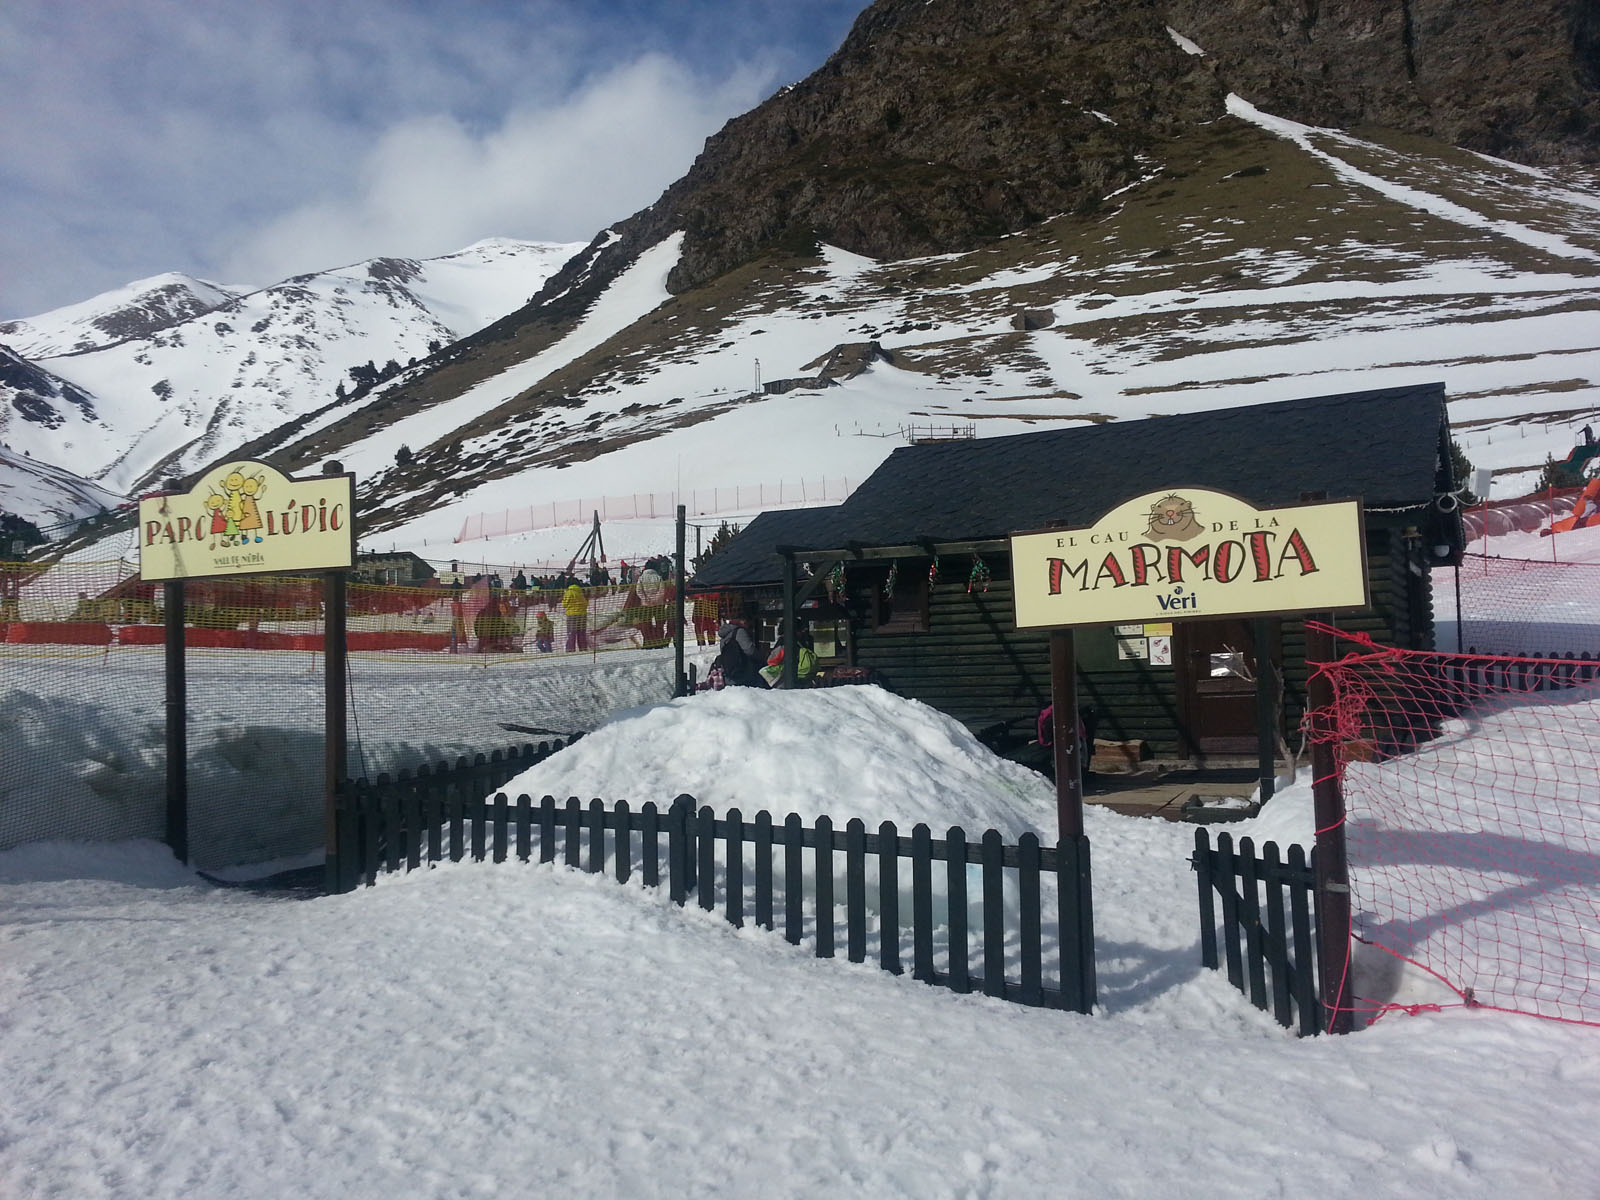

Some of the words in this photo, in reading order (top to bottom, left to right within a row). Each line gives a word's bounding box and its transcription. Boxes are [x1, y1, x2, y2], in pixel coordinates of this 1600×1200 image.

[145, 515, 206, 547] PARC
[1056, 537, 1078, 548] EL
[1090, 531, 1129, 545] CAU
[1212, 520, 1239, 533] DE
[1255, 516, 1281, 529] LA
[1046, 528, 1320, 596] MARMOTA
[1156, 592, 1197, 610] Veri
